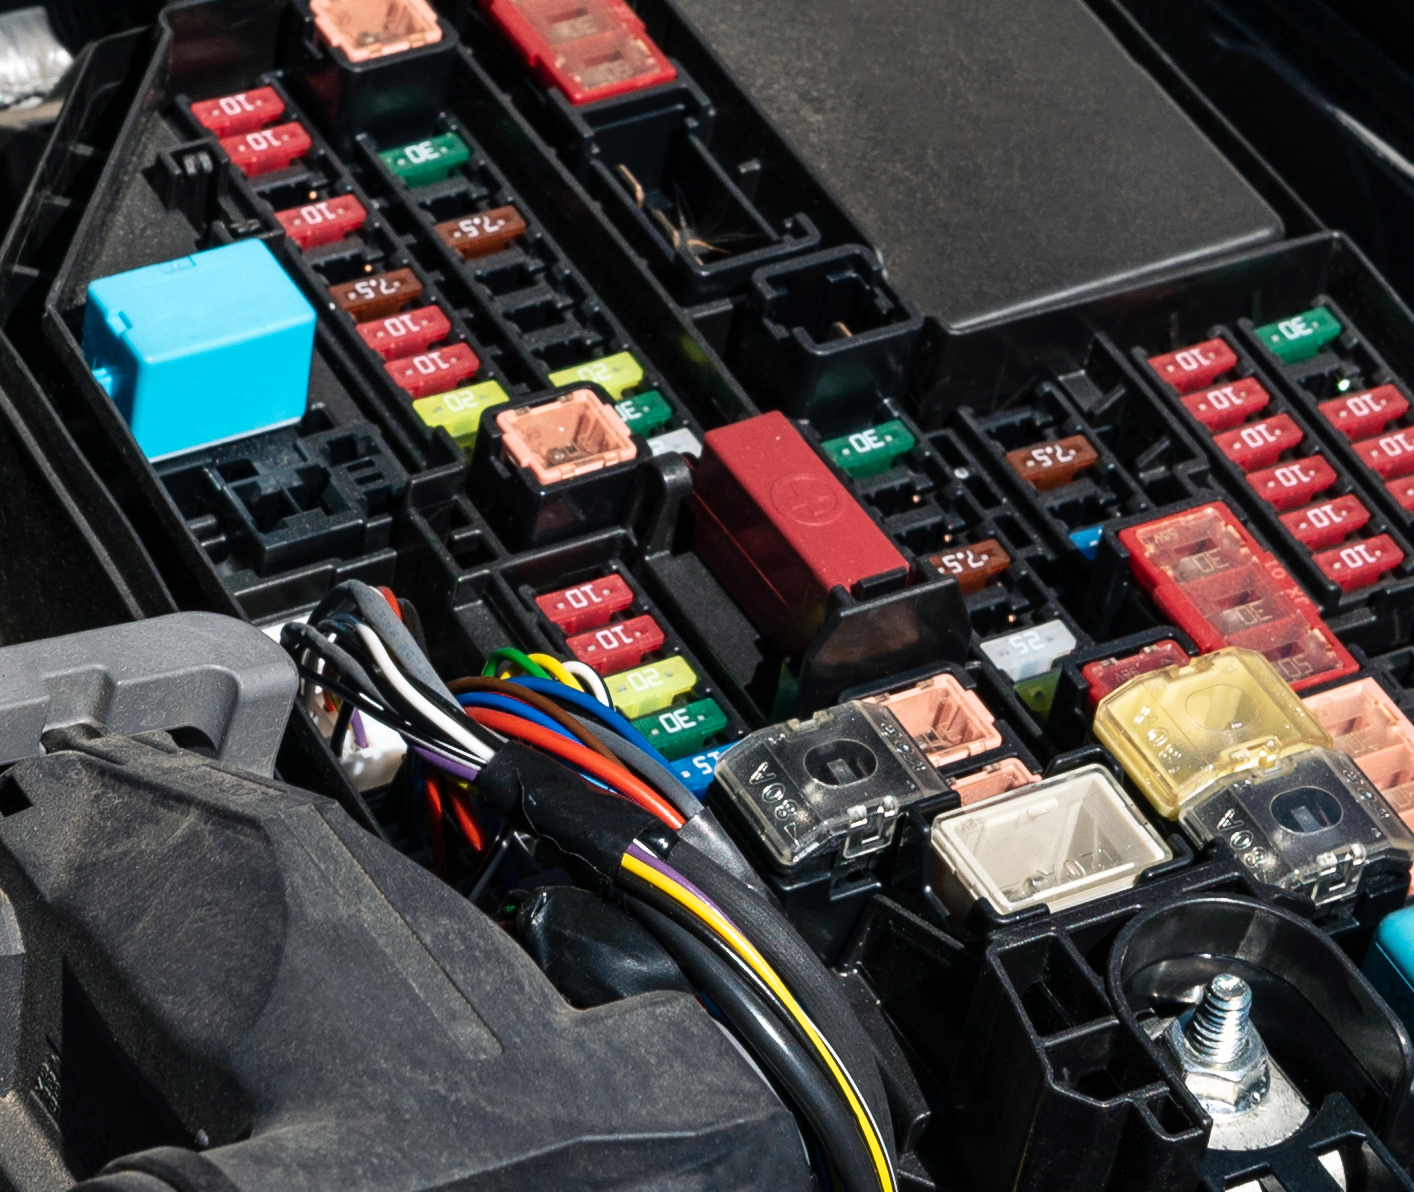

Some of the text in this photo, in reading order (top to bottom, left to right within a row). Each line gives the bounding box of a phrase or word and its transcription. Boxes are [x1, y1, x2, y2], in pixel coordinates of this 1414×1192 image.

[219, 94, 255, 116] 10
[246, 129, 283, 151] 10
[404, 140, 441, 165] 30
[300, 202, 337, 224] 10
[458, 215, 501, 238] 7.5
[355, 277, 397, 300] 7.5
[383, 313, 421, 338] 10
[1276, 315, 1314, 341] 30
[413, 351, 450, 375] 10
[1175, 346, 1209, 372] 10
[576, 362, 614, 386] 20
[442, 389, 479, 413] 20
[1207, 386, 1244, 411] 10
[1345, 392, 1383, 418] 10
[848, 428, 885, 454] 30
[1240, 424, 1278, 450] 10
[1031, 445, 1075, 468] 7.5
[1274, 463, 1311, 488] 10
[1307, 504, 1344, 529] 10
[941, 550, 987, 575] 7.5
[1339, 543, 1377, 569] 10
[565, 584, 602, 609] 10
[595, 625, 634, 650] 10
[1008, 630, 1045, 654] 25
[626, 667, 665, 692] 20
[658, 708, 697, 734] 30
